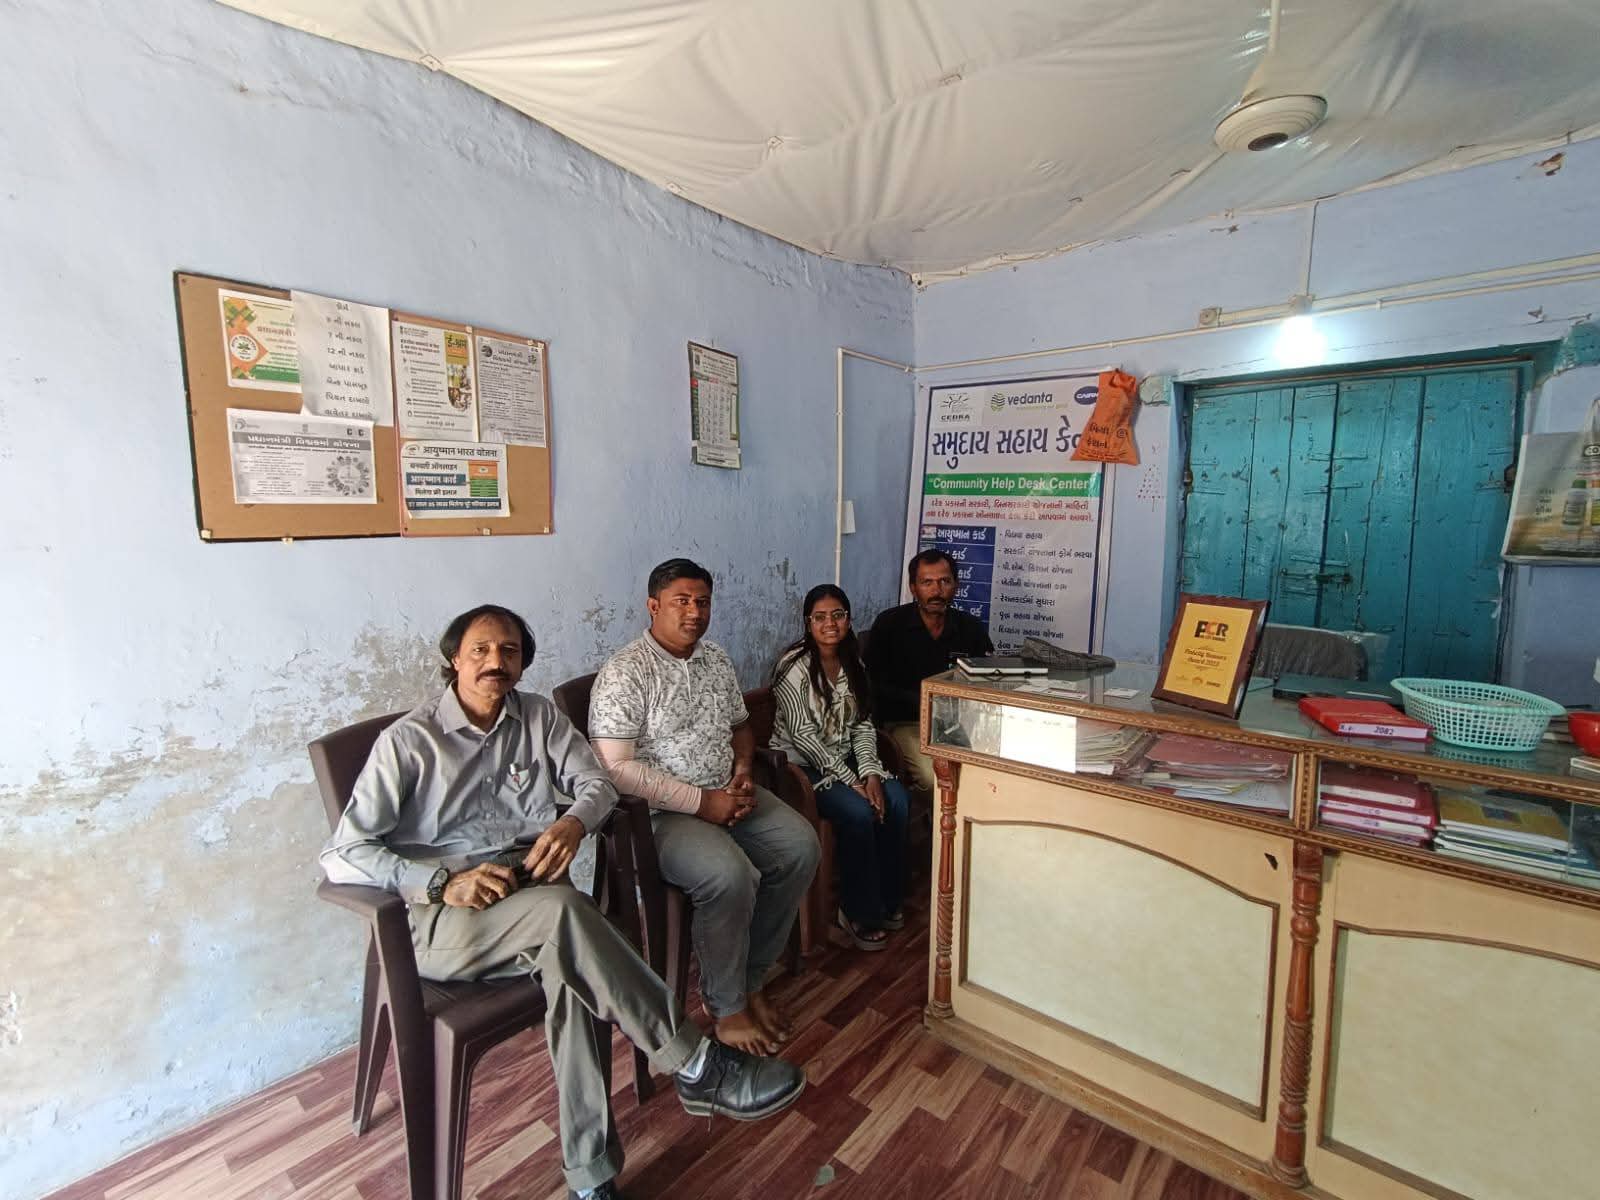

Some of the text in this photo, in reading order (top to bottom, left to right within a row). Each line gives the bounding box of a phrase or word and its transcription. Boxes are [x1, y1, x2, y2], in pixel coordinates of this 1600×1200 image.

[1007, 391, 1053, 406] vedanta
[423, 446, 497, 457] आयुष्मान भारत योजना
[933, 430, 990, 470] સમુદાય
[997, 427, 1049, 454] સહાય
[991, 477, 1015, 491] Help
[1018, 477, 1046, 490] Desk
[972, 527, 987, 540] કાર્ડ
[952, 547, 968, 560] કાર્ડ
[958, 567, 973, 579] કાર્ડ
